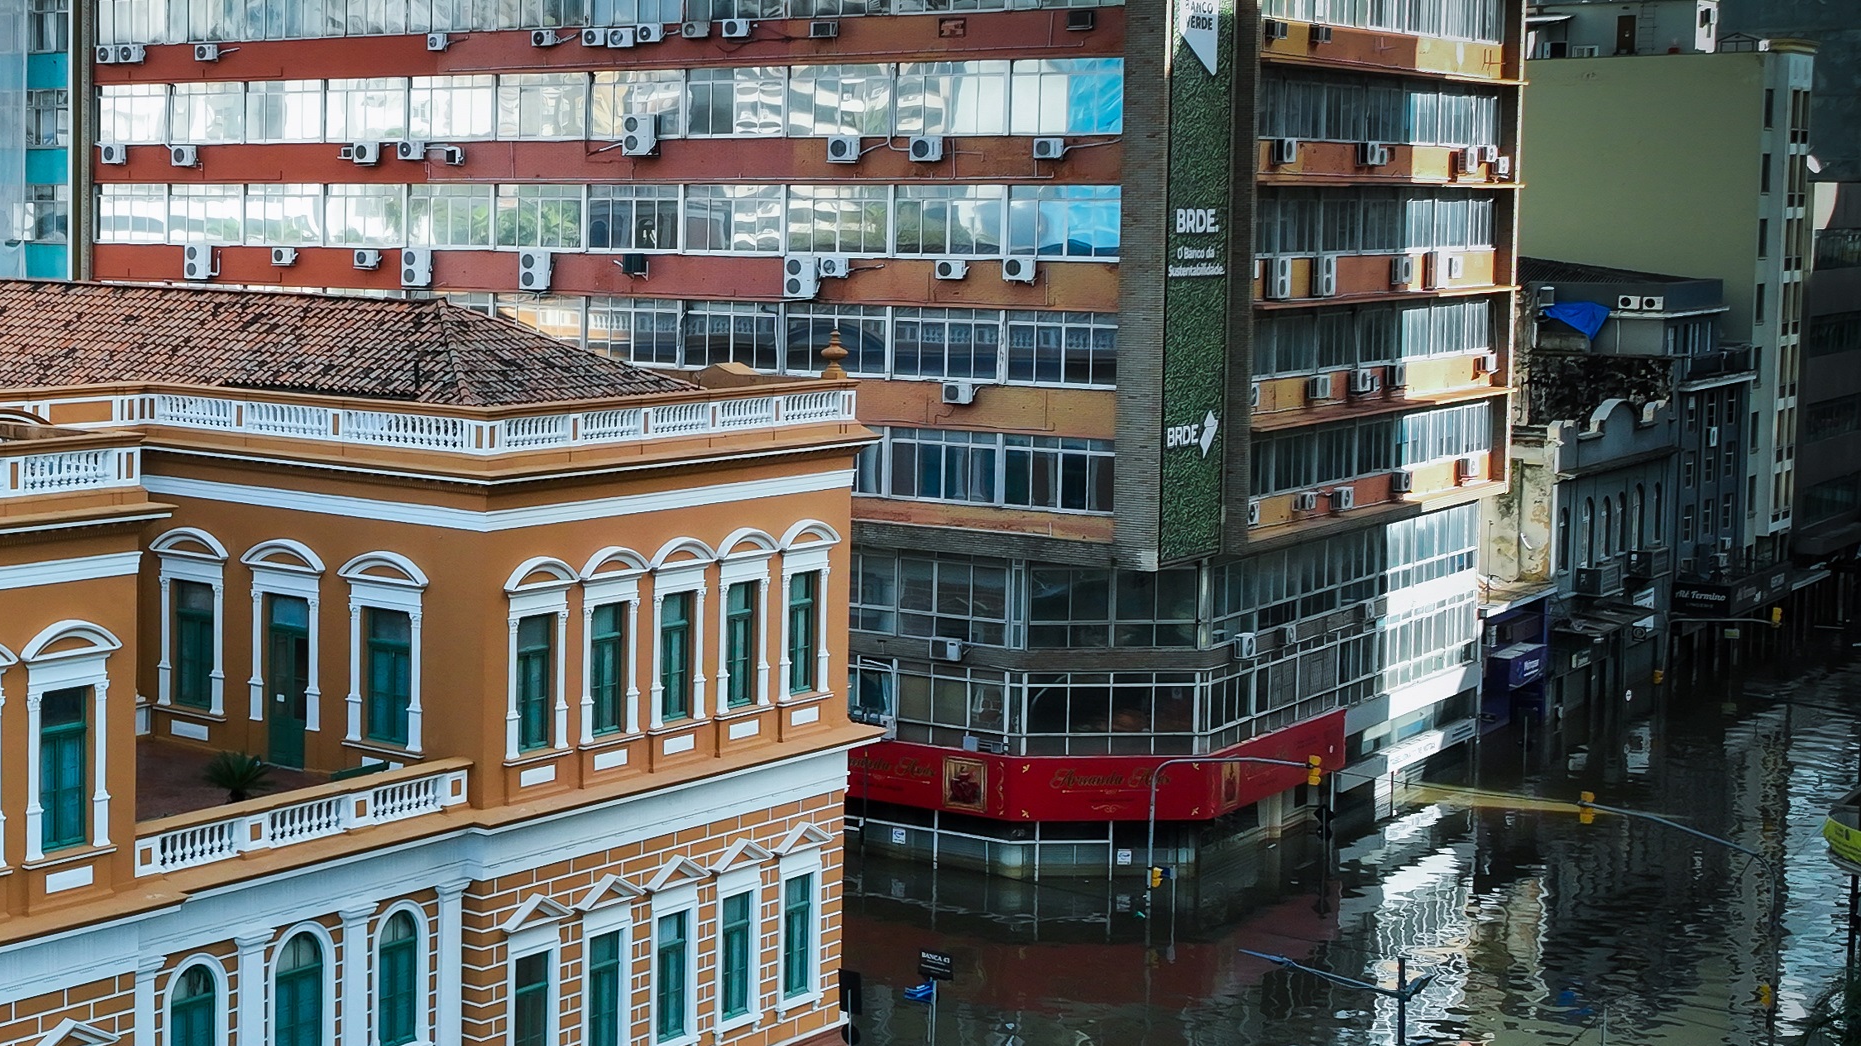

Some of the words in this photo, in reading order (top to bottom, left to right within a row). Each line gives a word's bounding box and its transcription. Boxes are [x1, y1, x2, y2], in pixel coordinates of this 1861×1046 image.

[1187, 15, 1213, 31] VERDE
[1183, 246, 1205, 259] Banco
[1206, 246, 1215, 258] da
[1167, 424, 1199, 447] BRDE
